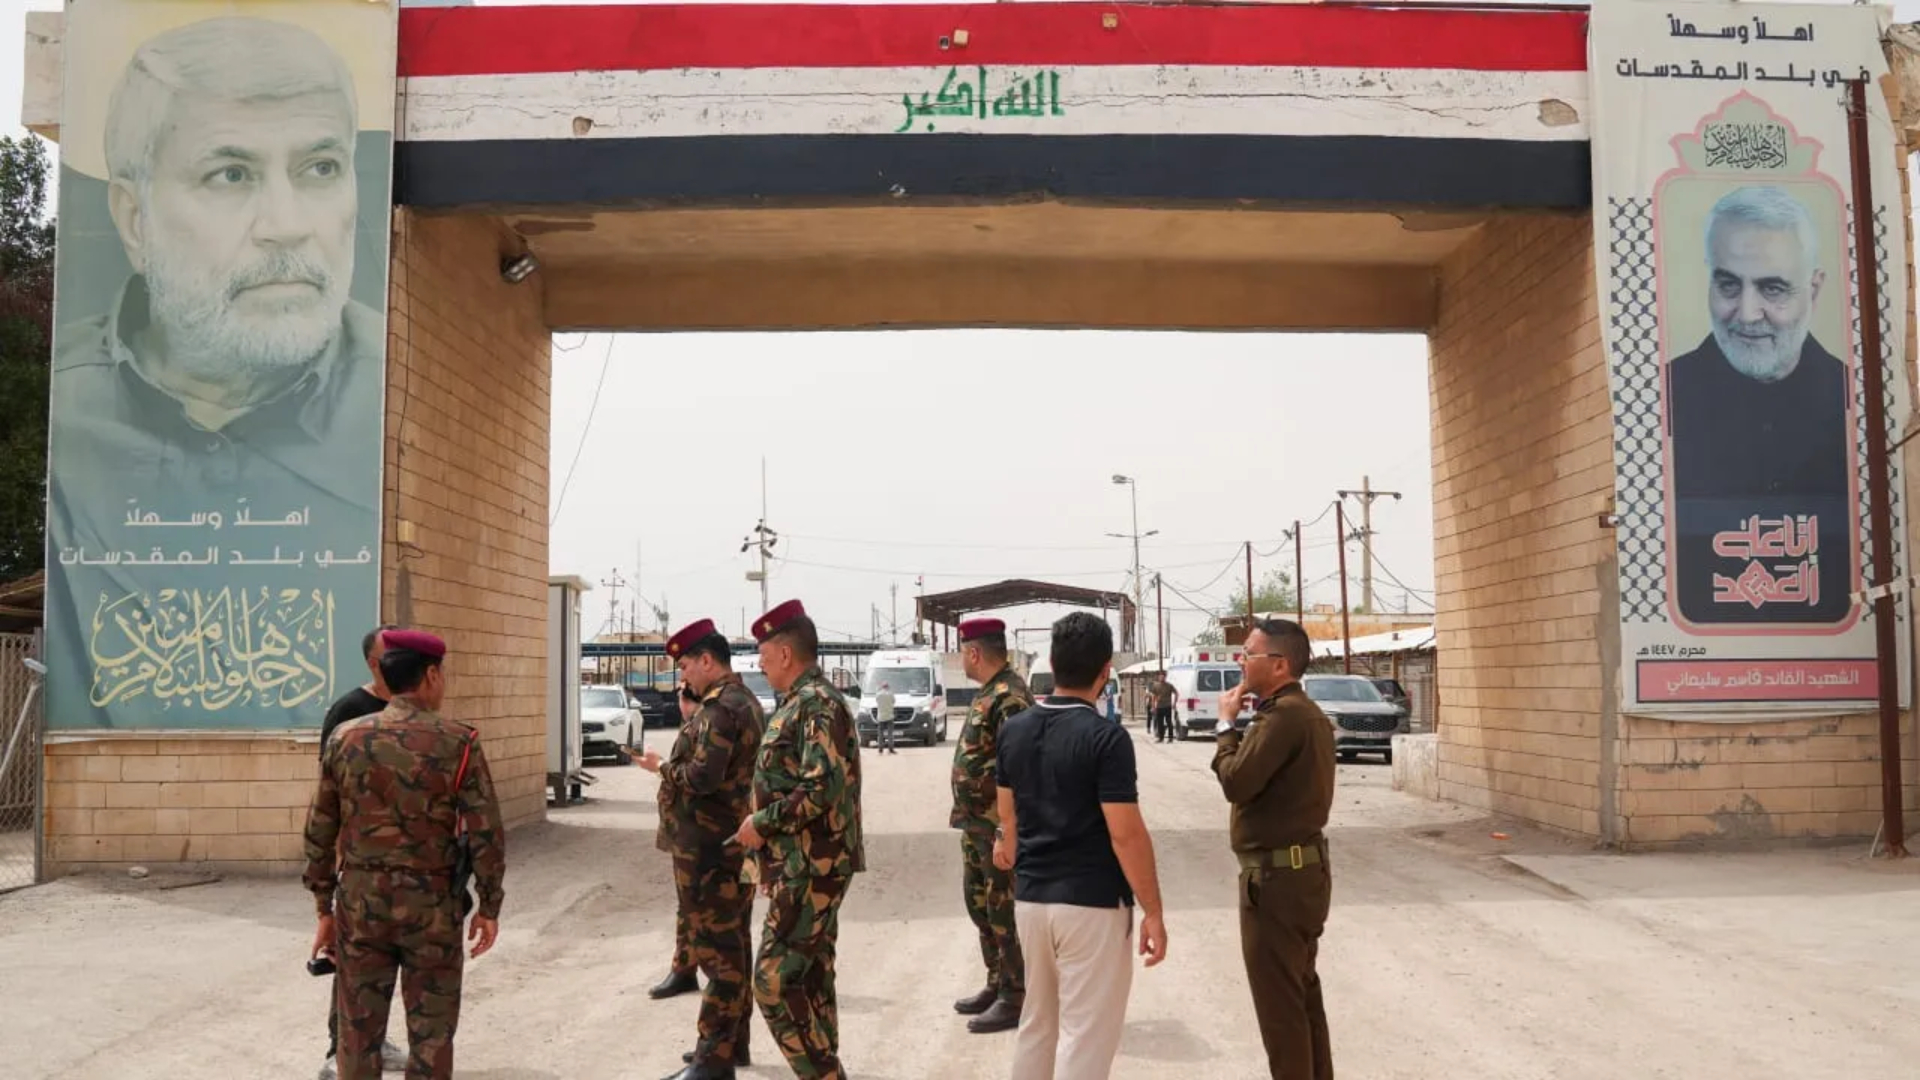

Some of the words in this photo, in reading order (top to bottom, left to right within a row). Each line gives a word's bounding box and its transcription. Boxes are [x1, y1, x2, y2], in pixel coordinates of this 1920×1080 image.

[1616, 58, 1748, 80] المقدسات
[1755, 63, 1815, 87] بلد
[1822, 66, 1871, 88] في
[993, 69, 1065, 117] الله
[60, 547, 218, 565] المقدسات
[229, 546, 303, 568] بلد
[314, 545, 372, 568] في
[1651, 644, 1675, 656] ١٤٤٧
[1678, 646, 1706, 657] محرم
[1667, 672, 1721, 694] سليماني
[1725, 669, 1761, 687] قاسم
[1808, 668, 1860, 688] الشهيد
